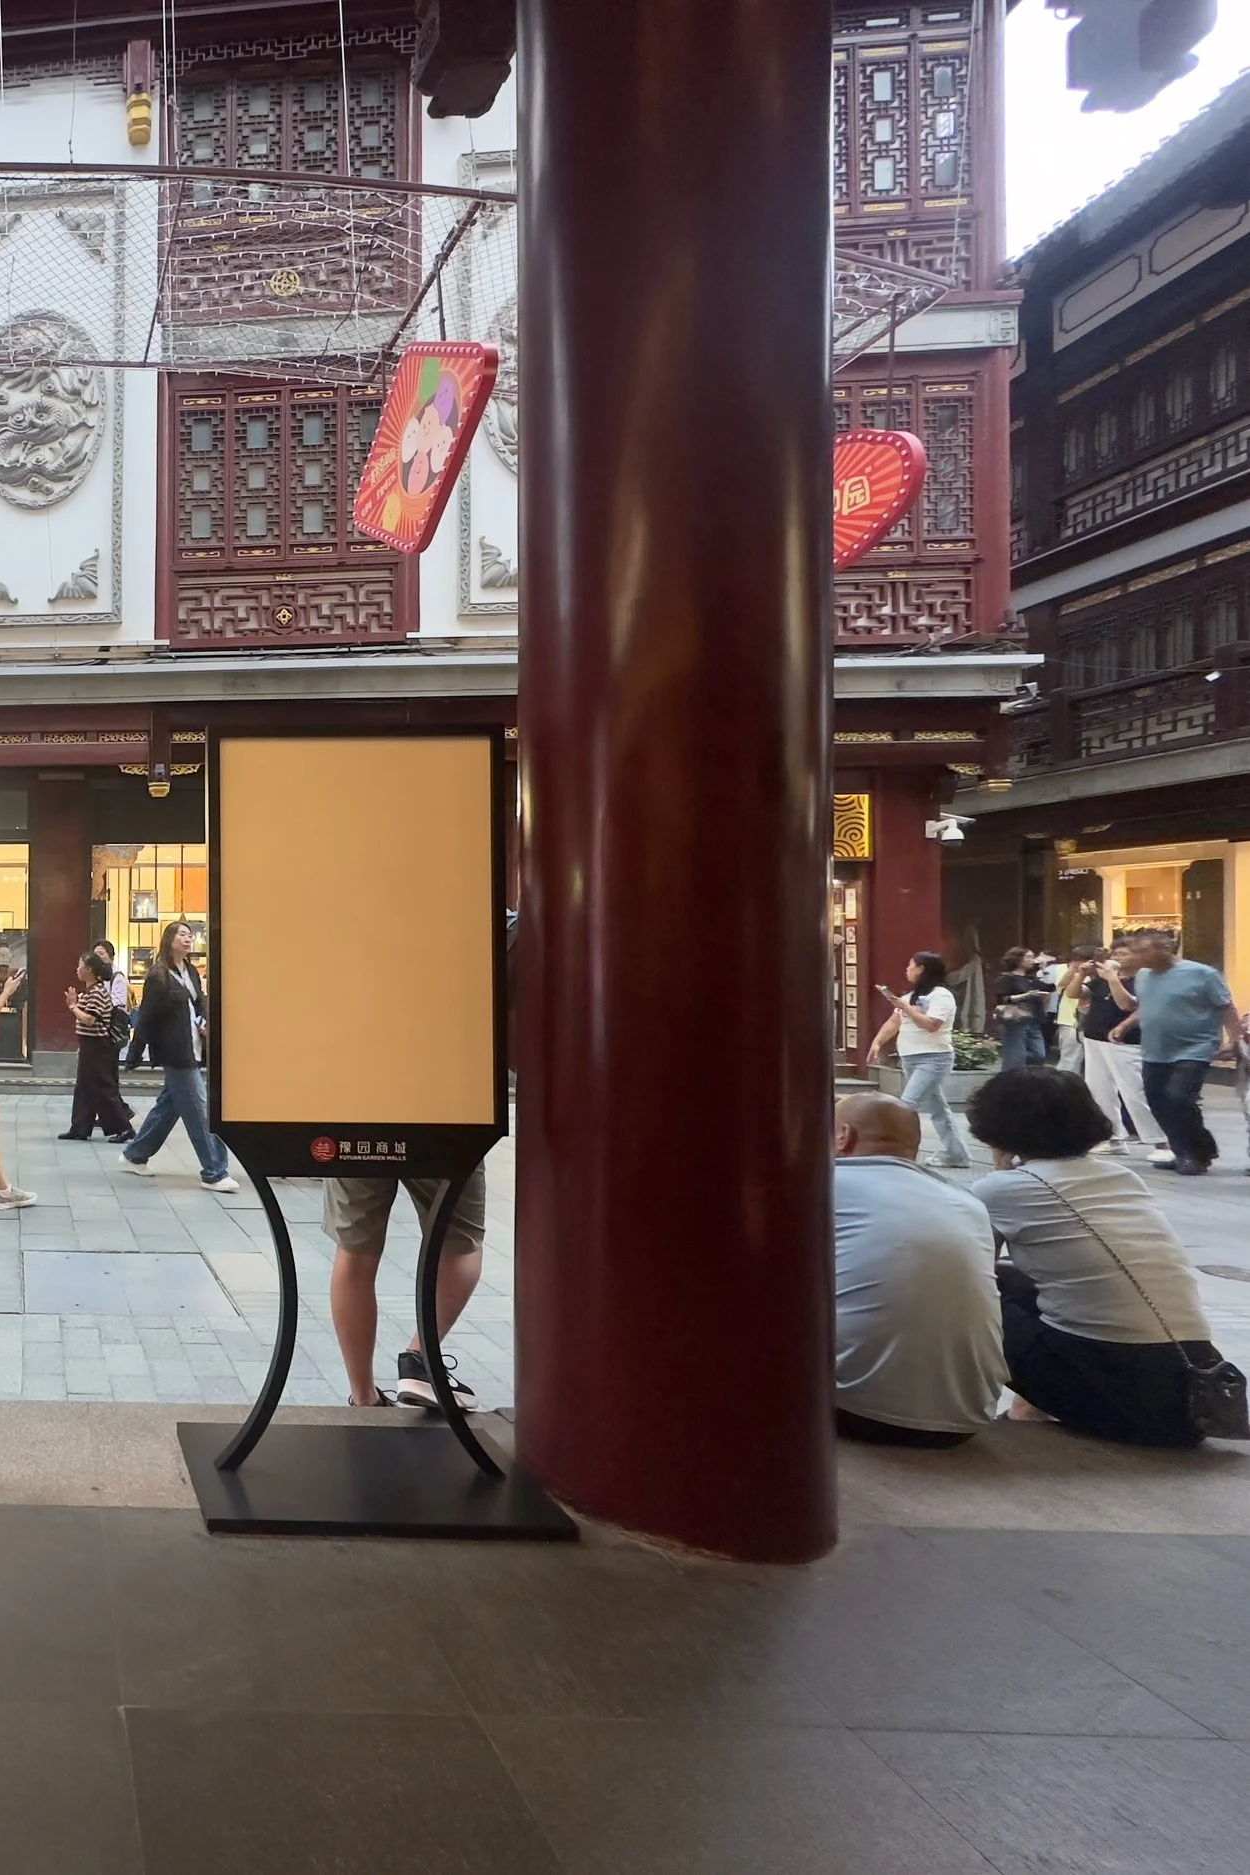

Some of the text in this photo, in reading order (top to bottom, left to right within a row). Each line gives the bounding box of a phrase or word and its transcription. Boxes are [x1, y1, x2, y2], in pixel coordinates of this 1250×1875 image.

[834, 476, 871, 515] 园
[339, 1141, 406, 1154] 豫园商城
